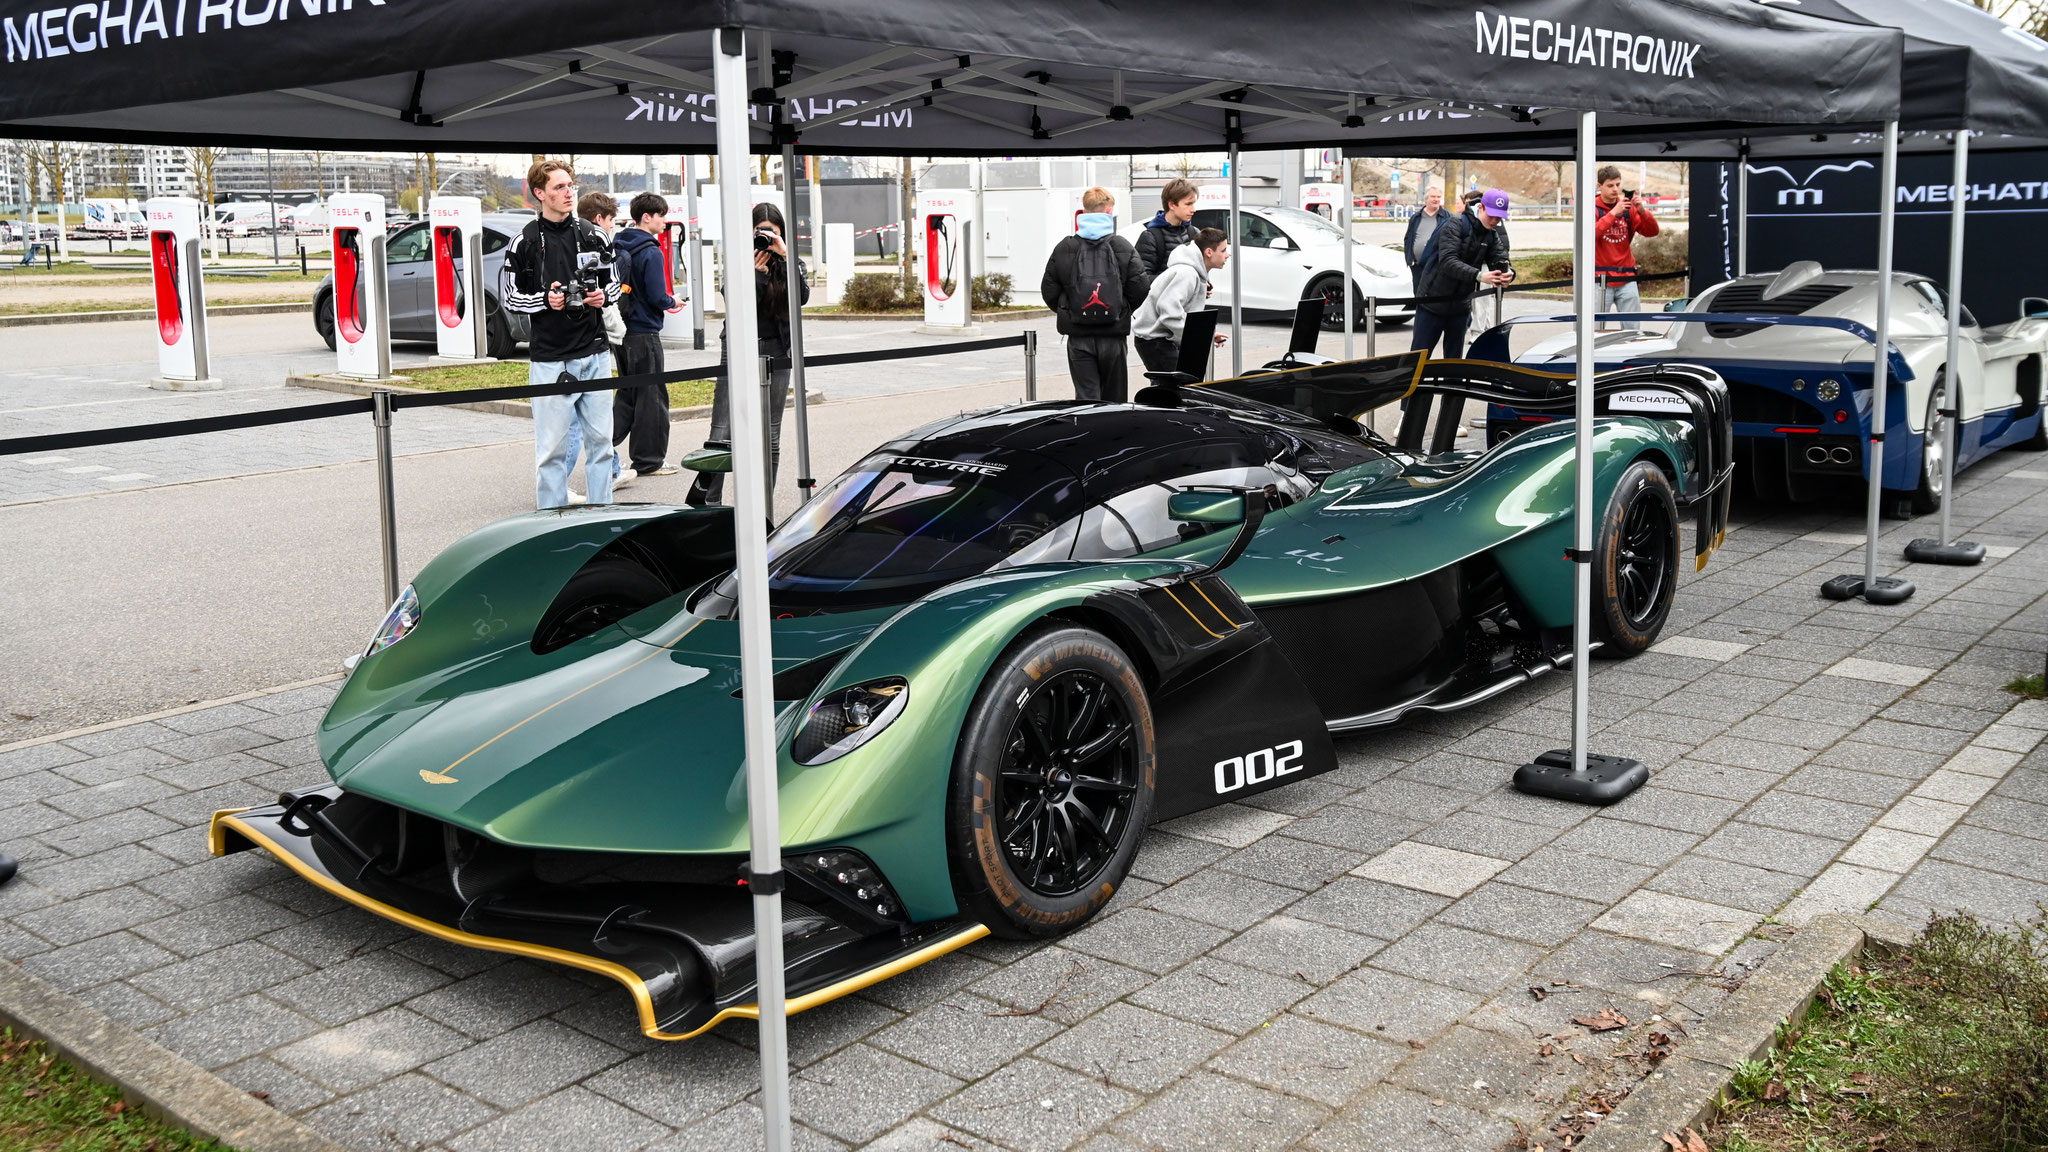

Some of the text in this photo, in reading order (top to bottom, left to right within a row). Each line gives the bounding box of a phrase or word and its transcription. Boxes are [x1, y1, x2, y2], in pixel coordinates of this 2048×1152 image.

[3, 0, 386, 62] MECHATRO
[1475, 11, 1701, 78] MECHATRONIK
[1896, 181, 2048, 203] MECHAT
[149, 212, 173, 220] TESLA
[332, 208, 360, 216] TESLA
[433, 209, 460, 217] TESLA
[1720, 161, 1732, 280] MECHAT
[1055, 642, 1123, 669] MICHELIN
[1214, 739, 1304, 795] 002
[983, 839, 998, 873] SPORT
